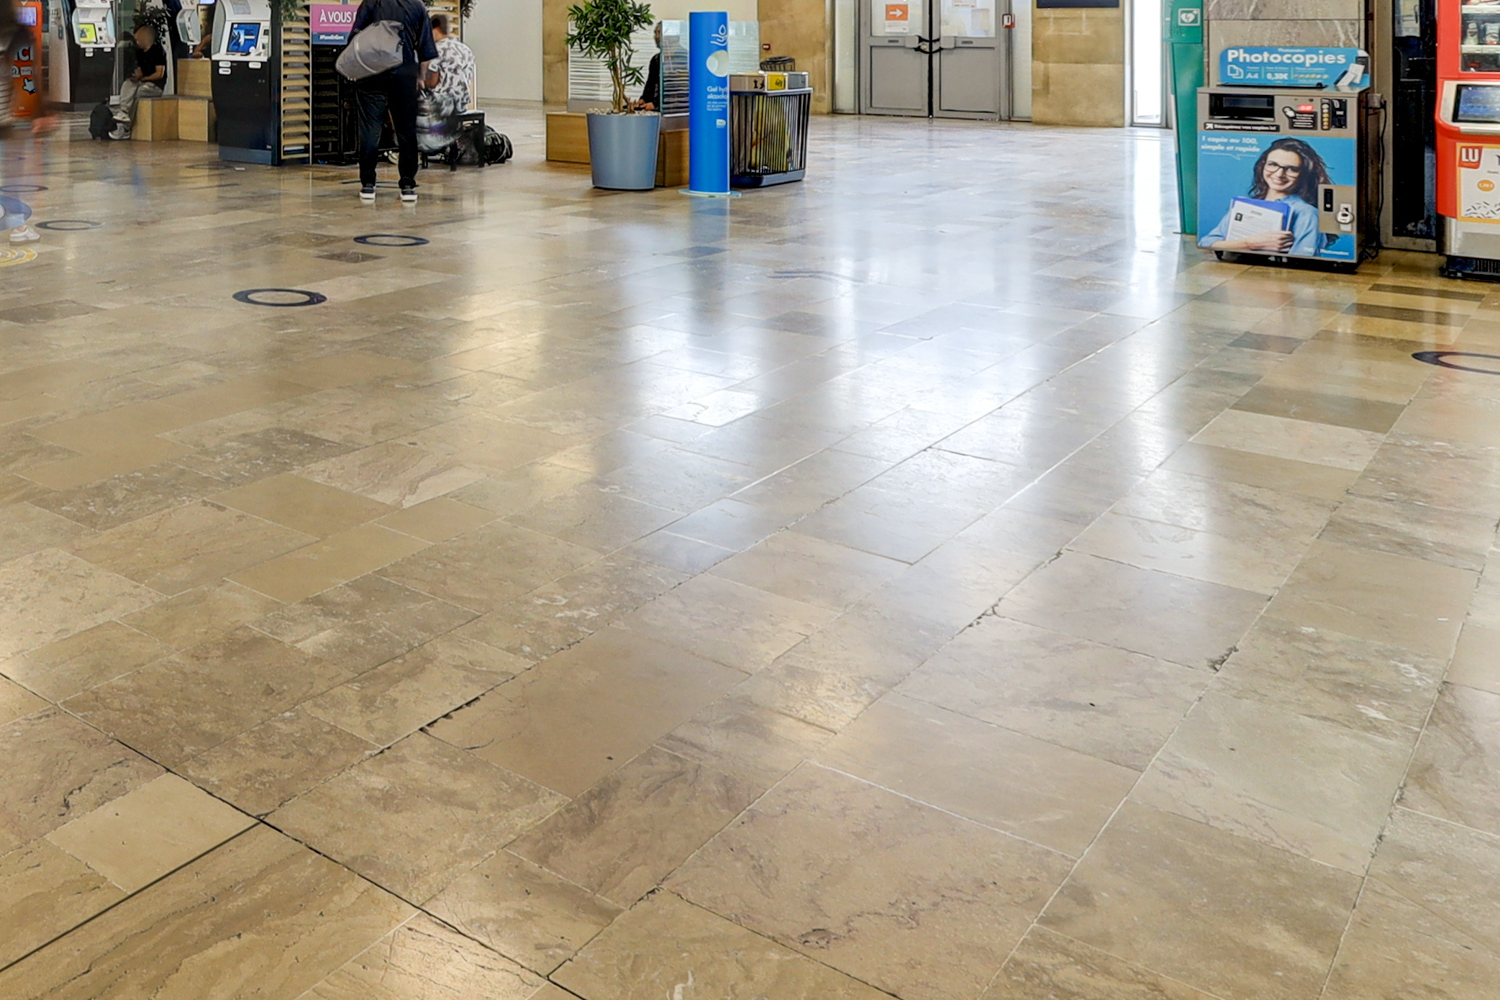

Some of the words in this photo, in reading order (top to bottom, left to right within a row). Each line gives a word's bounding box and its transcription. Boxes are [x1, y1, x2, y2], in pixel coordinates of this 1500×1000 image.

[320, 9, 327, 23] À
[328, 11, 352, 23] VOUS
[1227, 49, 1347, 67] Photocopies
[1201, 144, 1225, 152] simple
[1236, 145, 1260, 153] rapide
[1461, 147, 1480, 163] LU
